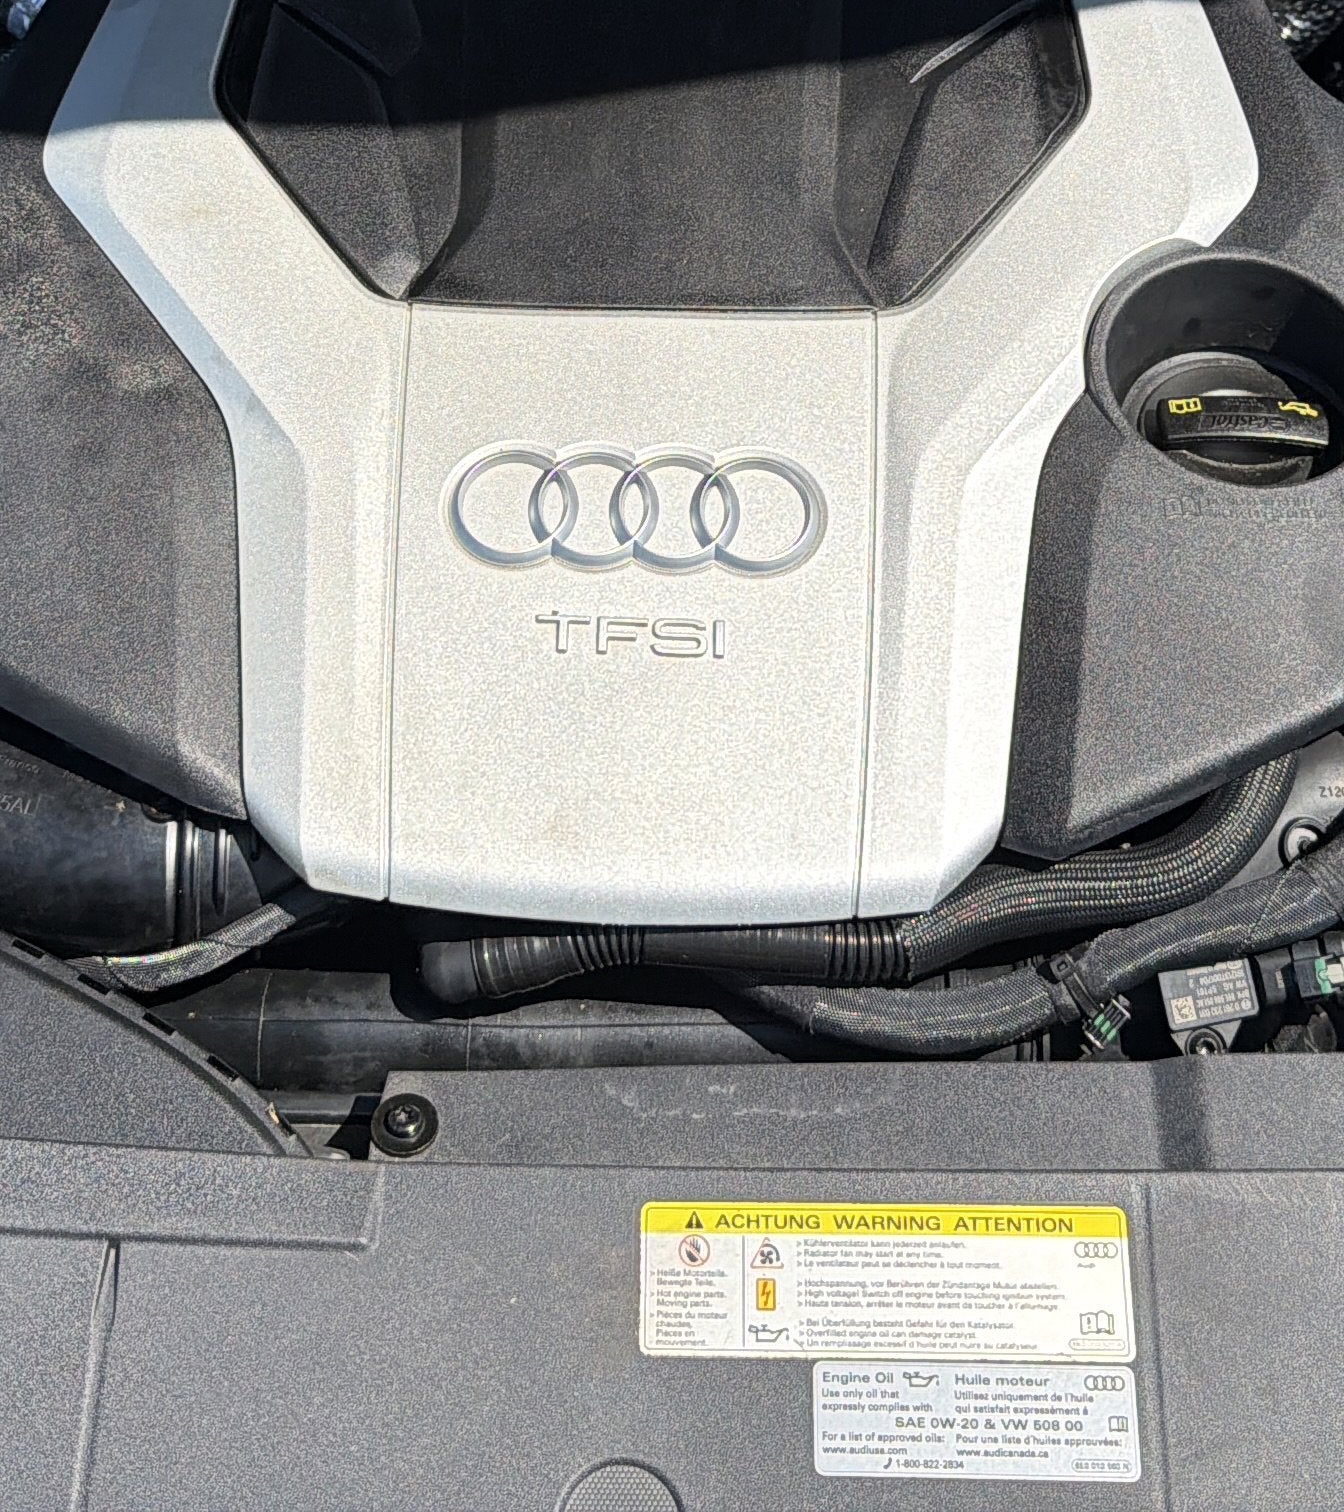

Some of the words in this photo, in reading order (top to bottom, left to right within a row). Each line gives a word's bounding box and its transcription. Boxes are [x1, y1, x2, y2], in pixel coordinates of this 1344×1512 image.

[1210, 414, 1269, 430] Castrol
[535, 610, 725, 660] TFSI
[714, 1213, 820, 1229] ACHTUNG
[833, 1214, 940, 1230] WARNING
[953, 1216, 1073, 1232] ATTENTION
[822, 1371, 870, 1385] Engine
[874, 1371, 893, 1383] Oil
[954, 1373, 990, 1386] Huile
[995, 1376, 1050, 1387] moteur
[821, 1387, 840, 1398] Use
[842, 1387, 863, 1400] only
[865, 1388, 877, 1398] oil
[880, 1389, 899, 1399] that
[953, 1390, 989, 1401] Utilisez
[990, 1392, 1048, 1402] uniquement
[1050, 1392, 1062, 1402] de
[821, 1402, 865, 1413] expressly
[867, 1401, 910, 1412] complies
[911, 1402, 933, 1412] with
[954, 1403, 970, 1414] qui
[973, 1403, 1010, 1414] satisfait
[1082, 1406, 1088, 1415] à
[894, 1416, 925, 1428] SAE
[930, 1417, 978, 1429] 0W-20
[983, 1418, 996, 1430] &
[1000, 1418, 1028, 1430] VW
[1033, 1419, 1060, 1431] 508
[1064, 1419, 1083, 1431] 00
[821, 1430, 838, 1441] For
[840, 1433, 846, 1441] a
[848, 1431, 862, 1441] list
[864, 1431, 875, 1441] of
[877, 1433, 922, 1444] approved
[924, 1433, 945, 1443] oils:
[955, 1433, 978, 1444] Pour
[980, 1435, 998, 1444] une
[1001, 1434, 1021, 1444] liste
[821, 1445, 907, 1455] www.audiusa.com
[955, 1447, 1049, 1458] www.audicanada.ca
